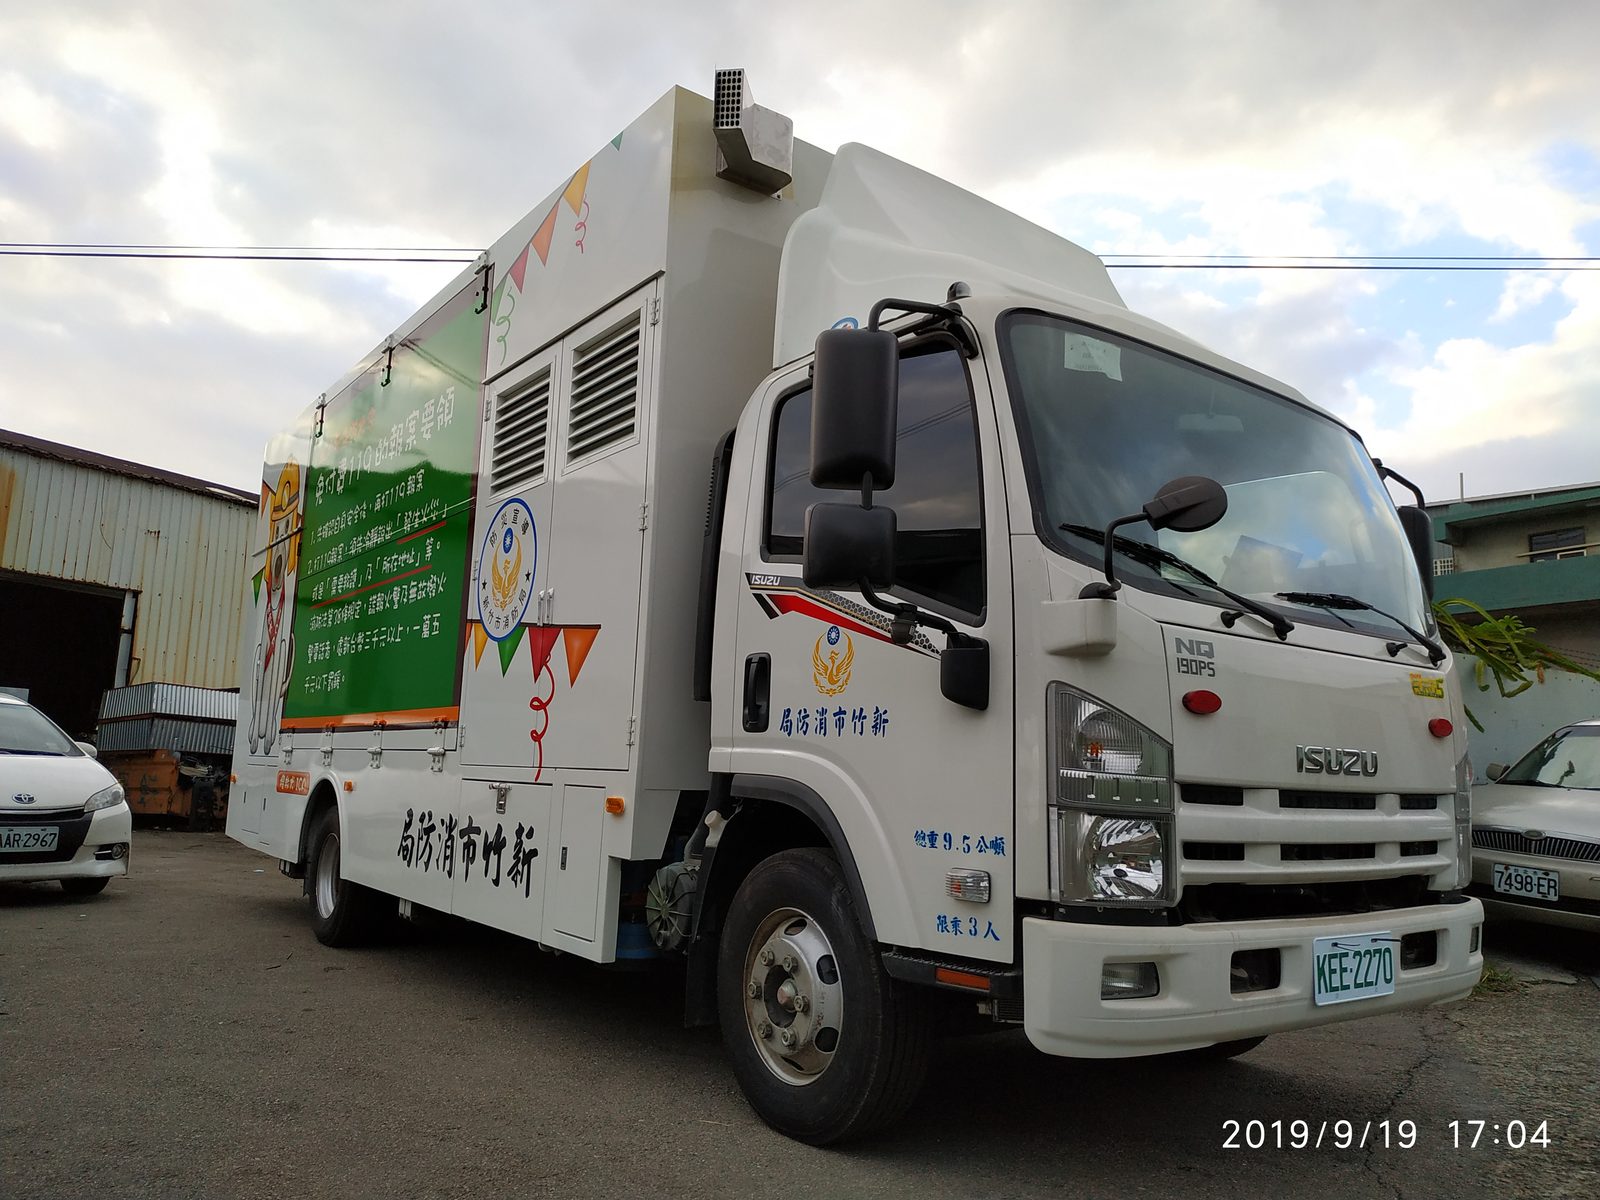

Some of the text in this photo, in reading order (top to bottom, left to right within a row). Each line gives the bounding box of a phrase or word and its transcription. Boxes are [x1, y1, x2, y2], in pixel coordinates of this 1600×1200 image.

[751, 574, 781, 586] ISUZU
[1174, 637, 1215, 659] NQ
[1176, 657, 1216, 678] 190PS
[1296, 744, 1378, 777] ISUZU
[1316, 946, 1393, 995] KEE-2270
